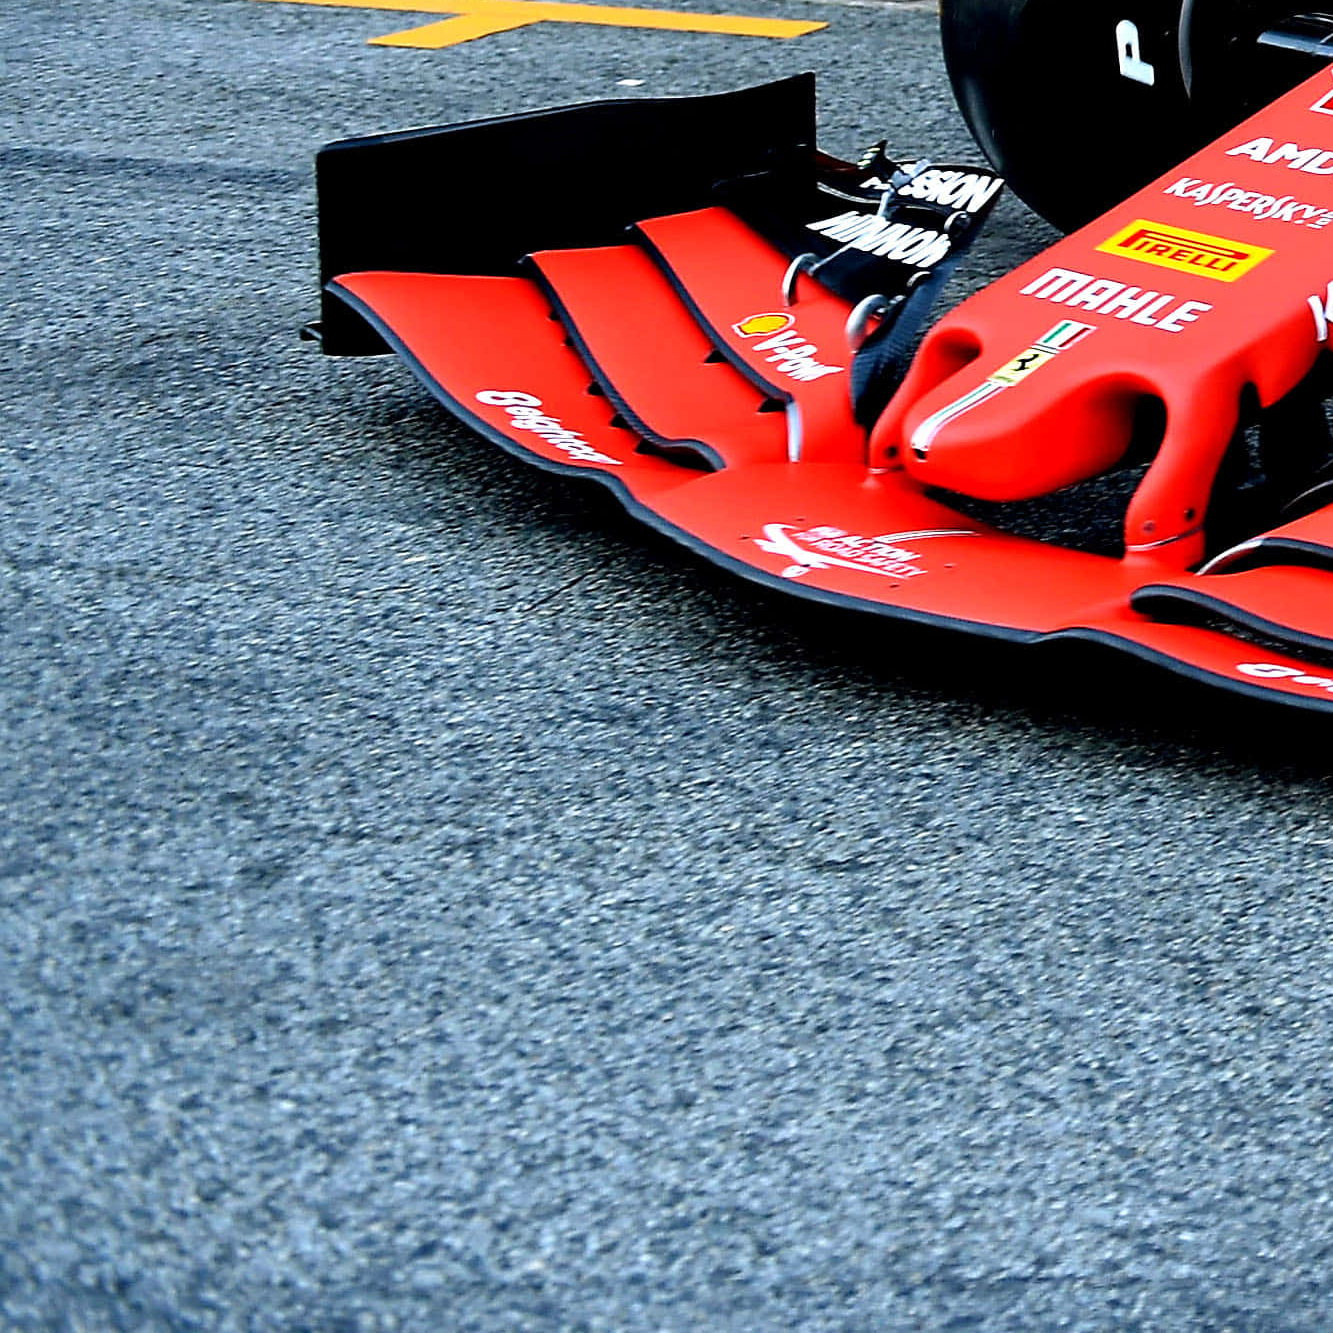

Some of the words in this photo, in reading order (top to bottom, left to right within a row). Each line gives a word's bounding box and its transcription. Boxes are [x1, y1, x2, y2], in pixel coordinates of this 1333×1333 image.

[1115, 19, 1154, 86] P
[1163, 177, 1326, 224] KASPERSKY
[805, 211, 952, 268] WINNOW
[1117, 228, 1250, 272] PIRELLI
[1018, 267, 1213, 333] MAHLE
